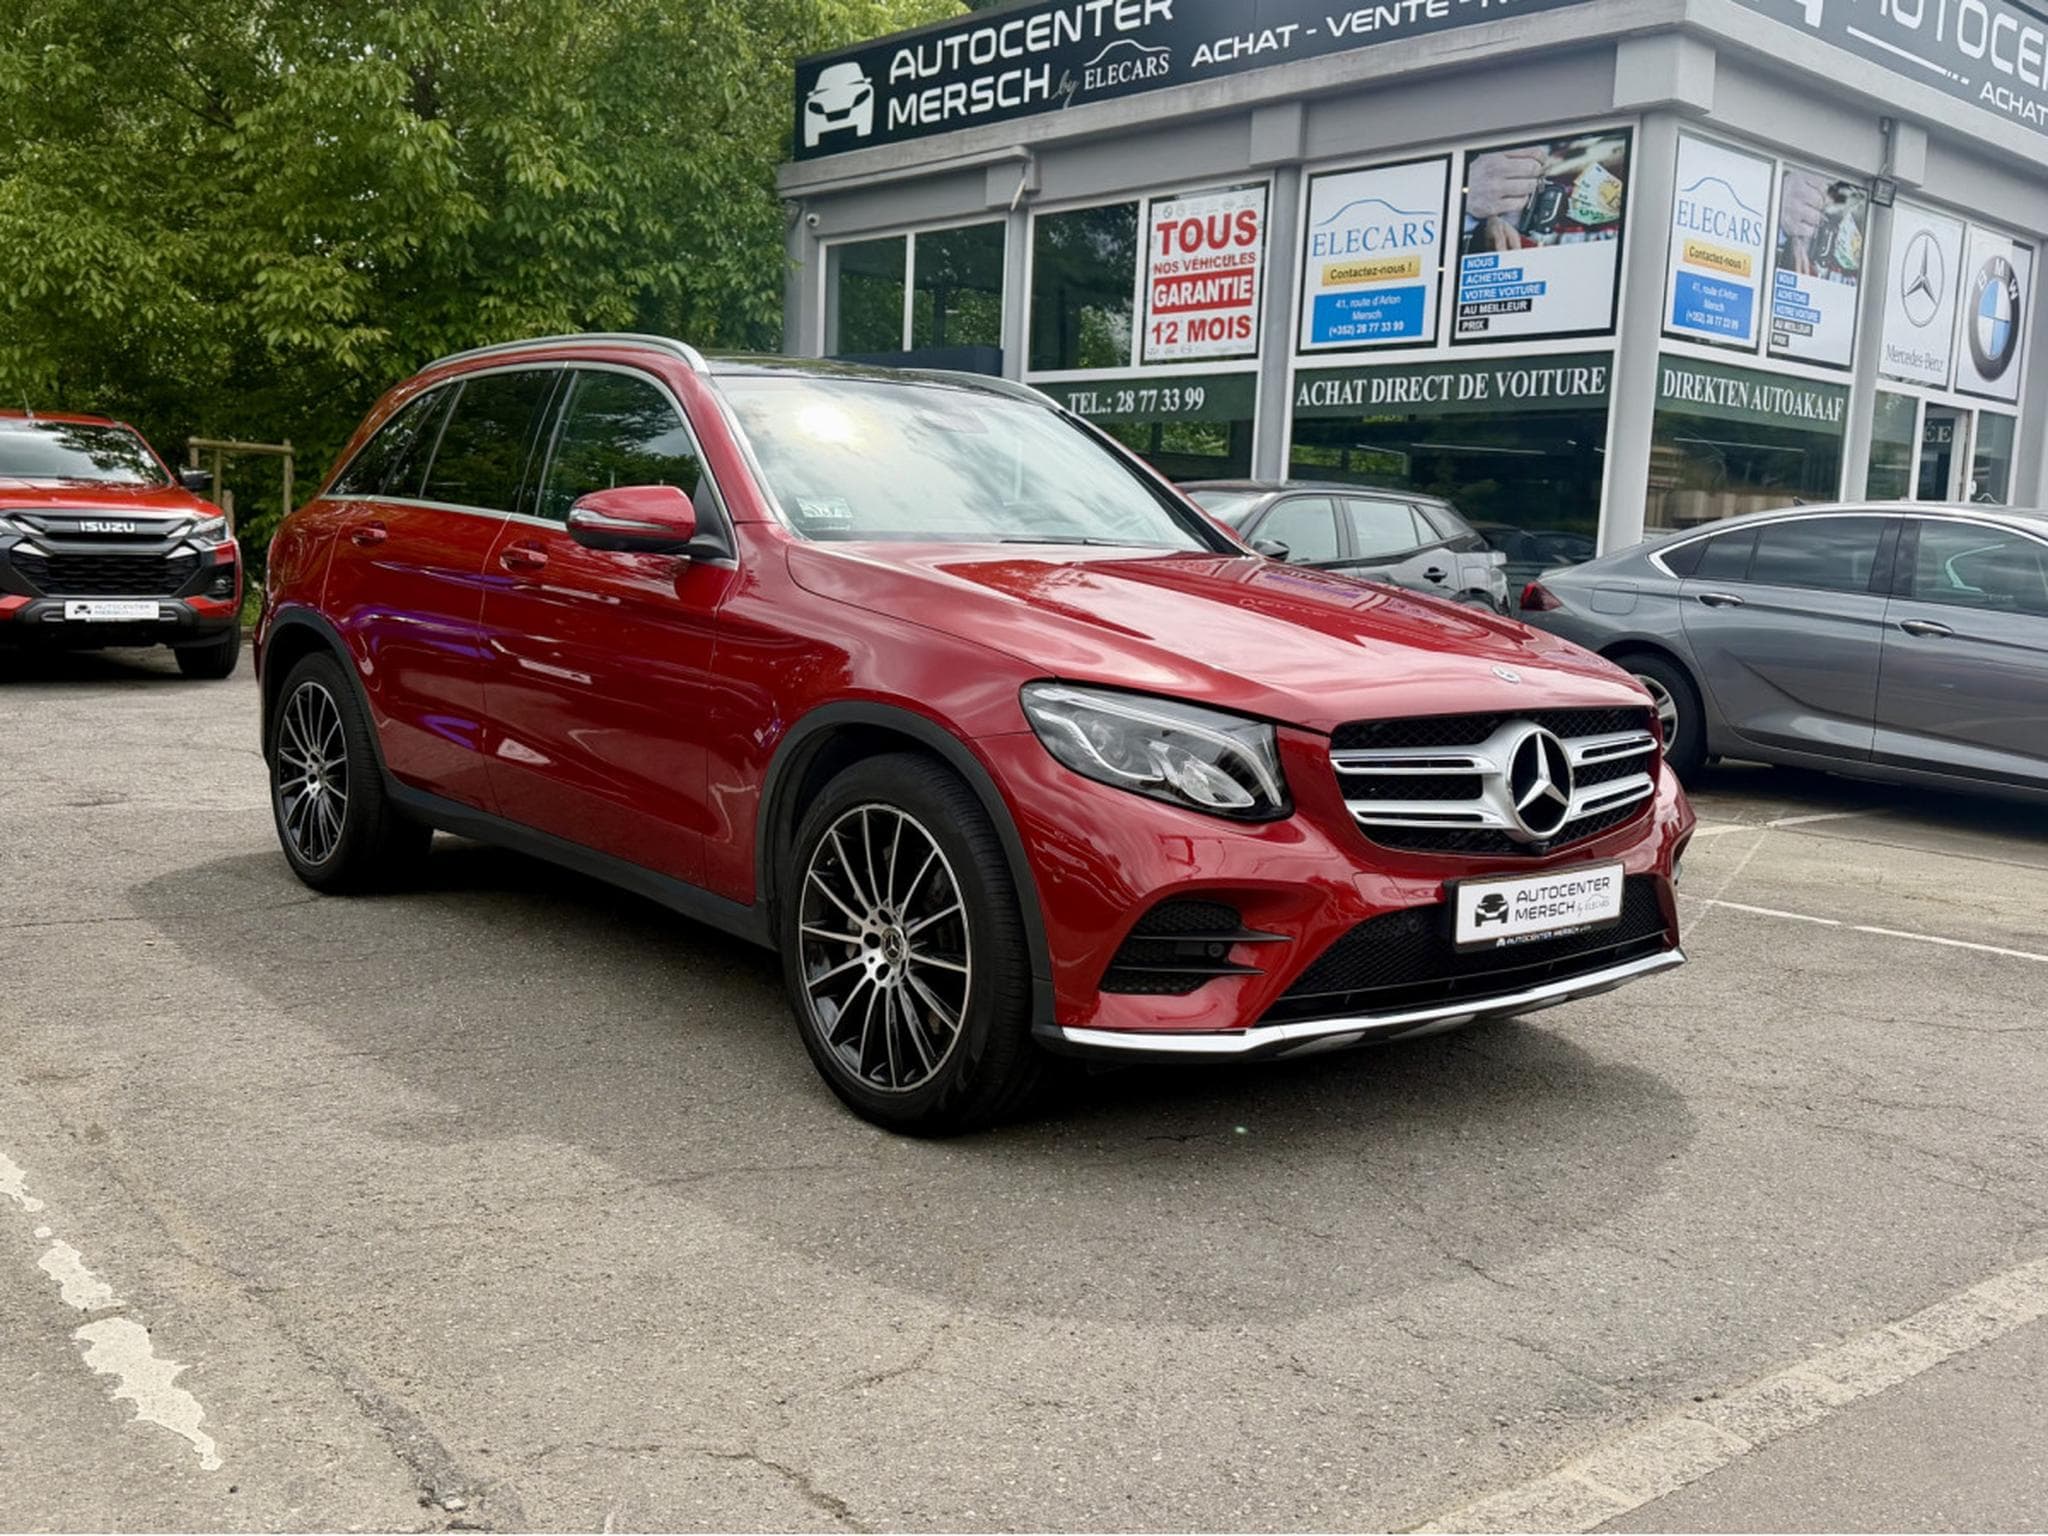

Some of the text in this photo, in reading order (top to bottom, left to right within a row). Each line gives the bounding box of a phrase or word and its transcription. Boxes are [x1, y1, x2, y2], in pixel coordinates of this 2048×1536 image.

[889, 0, 1174, 85] AUTOCENTER
[1191, 24, 1298, 67] ACHAT
[1325, 0, 1449, 37] VENTE
[888, 63, 1050, 130] MERSCH
[1083, 53, 1169, 91] ELECARS
[1980, 81, 2048, 126] ACHAT
[1157, 210, 1258, 256] TOUS
[1676, 200, 1762, 247] ELECARS
[1312, 220, 1435, 257] ELECARS
[1153, 260, 1179, 275] NOS
[1330, 263, 1405, 280] Contactez-nous
[1466, 257, 1494, 269] NOUS
[1154, 275, 1251, 308] GARANTIE
[1465, 270, 1518, 285] ACHETONS
[1464, 284, 1540, 300] VOTRE VOITURE
[1463, 301, 1528, 315] AU MEILLEUR
[1152, 315, 1252, 345] 12 MOIS
[1461, 320, 1485, 331] PRIX
[1297, 366, 1606, 406] ACHAT DIRECT DE VOITURE
[1662, 369, 1844, 422] DIREKTEN AUTOAKAAF
[1068, 387, 1205, 414] TEL.: 28 77 33 99
[79, 521, 135, 533] ISUZU
[1516, 876, 1610, 903] AUTOCENTER
[1514, 901, 1576, 921] MERSCH
